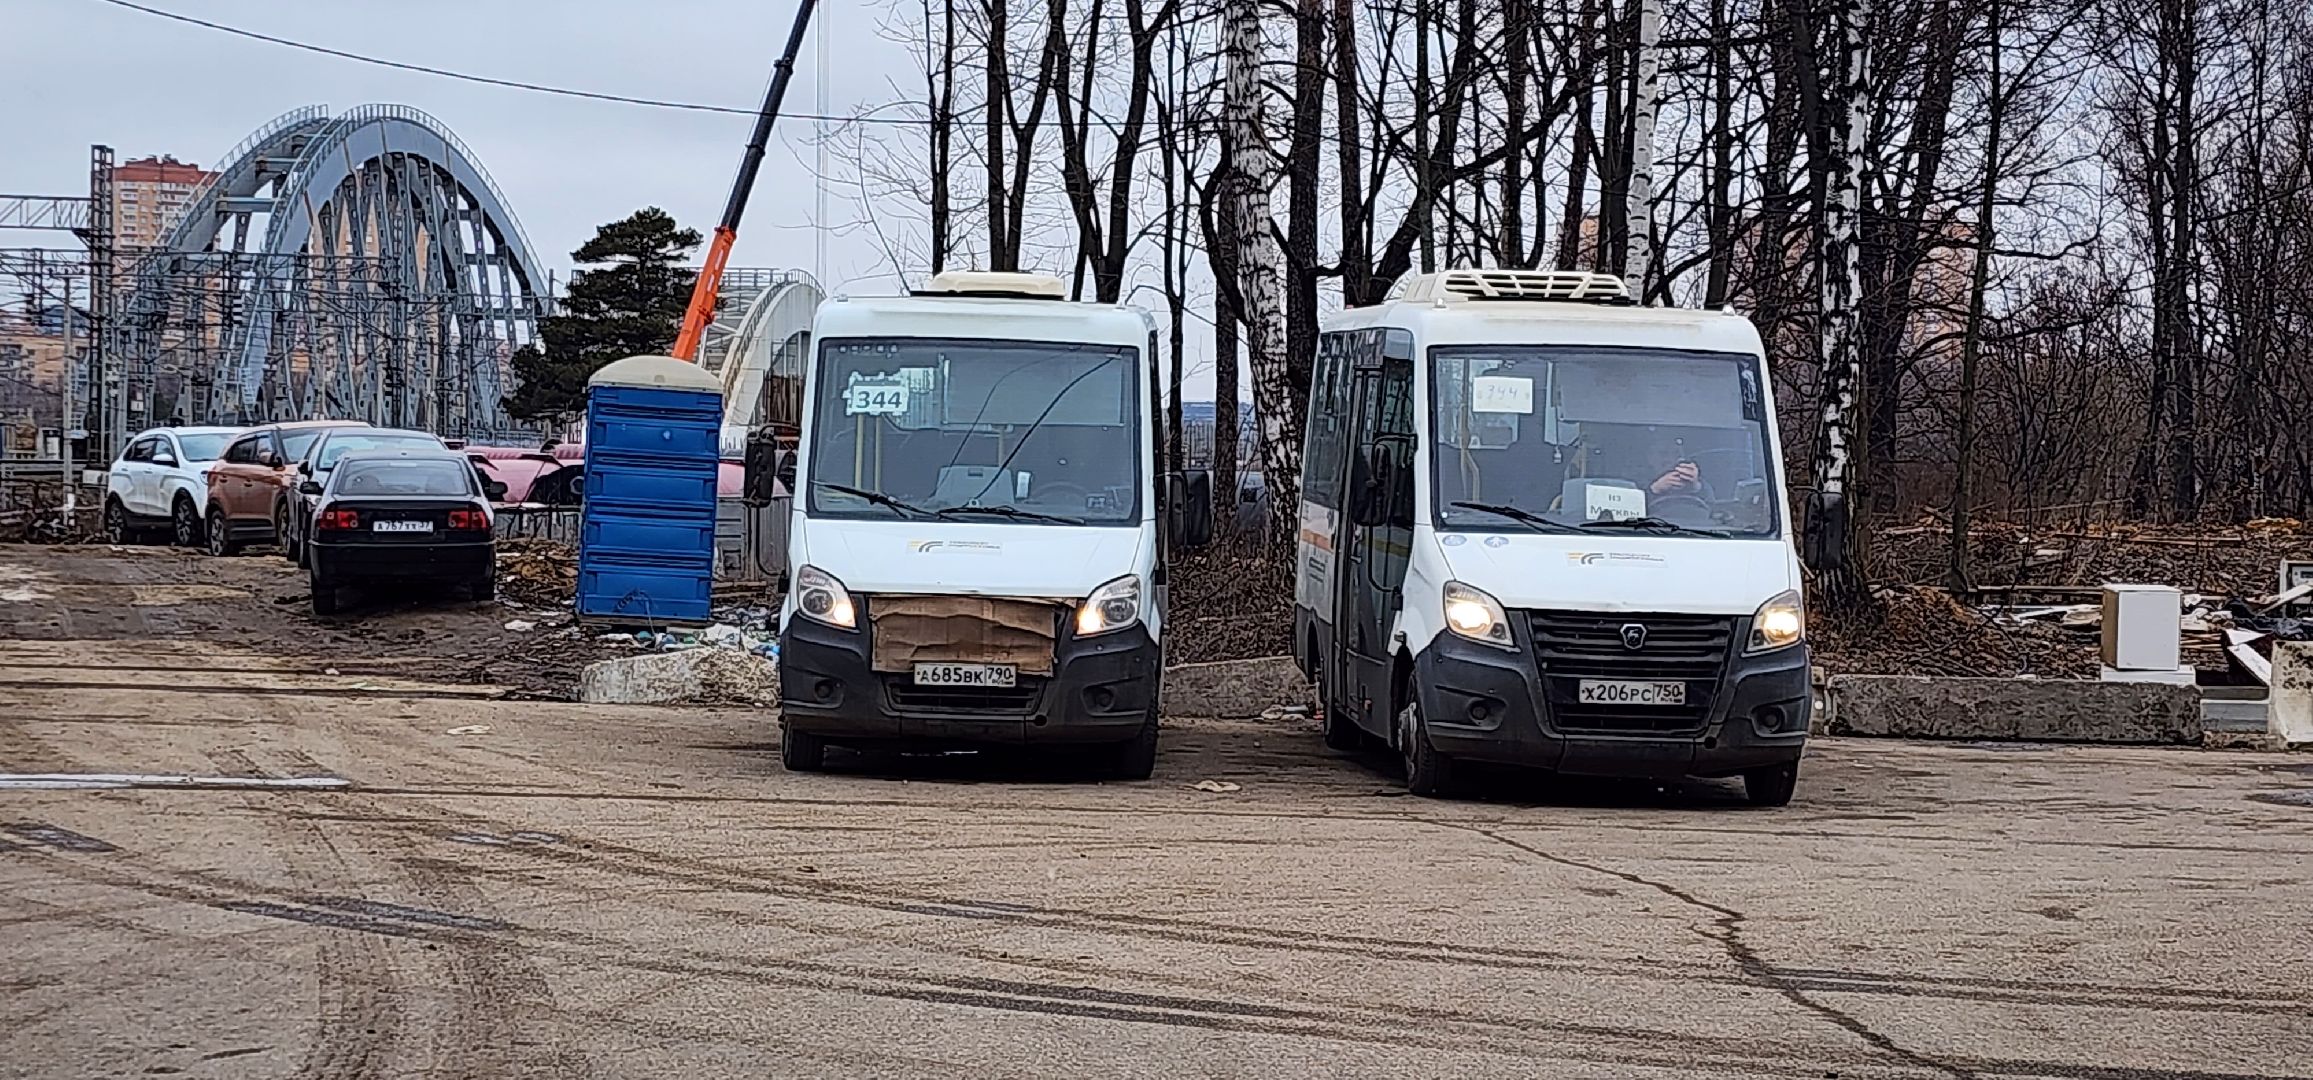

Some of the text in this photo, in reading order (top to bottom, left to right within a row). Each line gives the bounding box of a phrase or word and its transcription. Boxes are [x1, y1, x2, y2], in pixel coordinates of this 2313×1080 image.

[856, 390, 903, 409] 344
[1486, 384, 1518, 400] 344
[987, 667, 1012, 680] 790
[1653, 684, 1681, 698] 750
